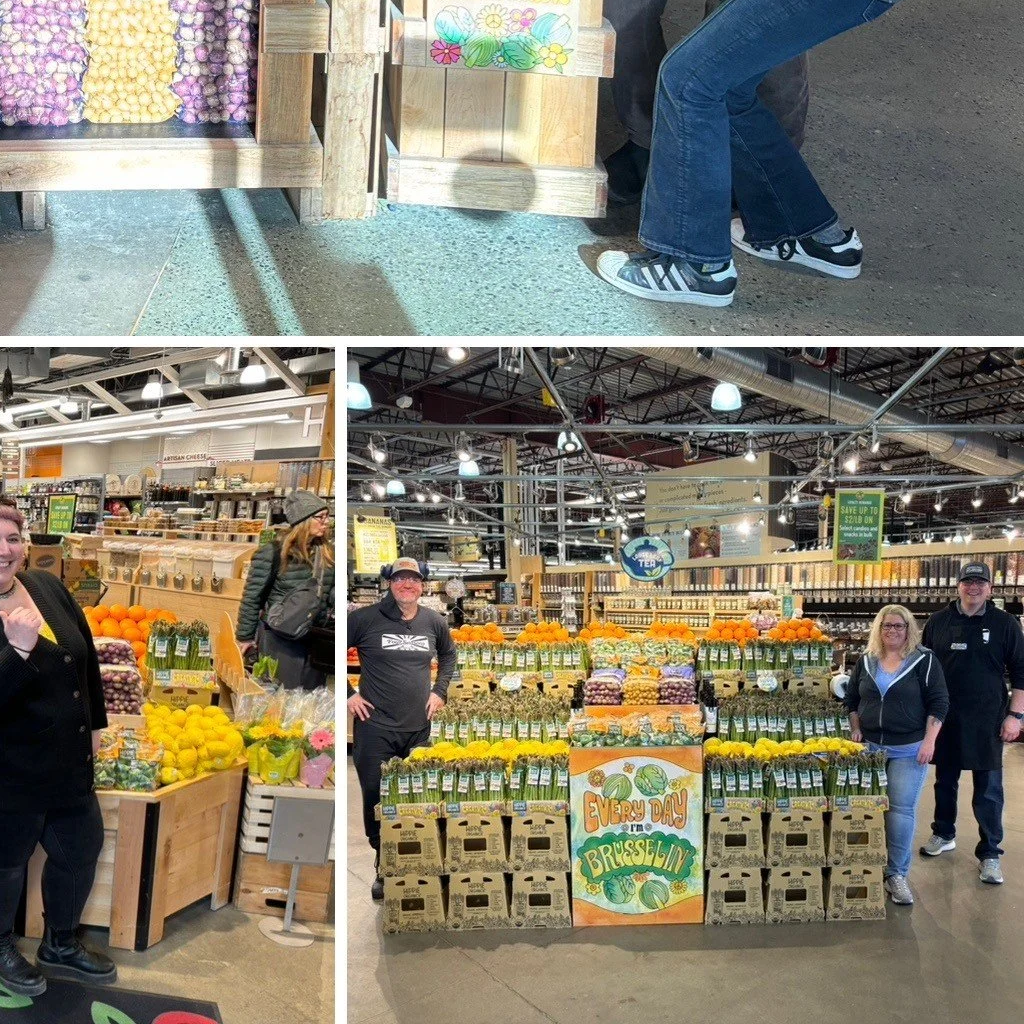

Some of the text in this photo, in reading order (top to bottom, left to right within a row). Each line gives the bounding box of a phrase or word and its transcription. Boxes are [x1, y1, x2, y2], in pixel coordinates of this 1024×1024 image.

[163, 454, 184, 462] ARTISAN
[841, 506, 879, 515] SAVE UP TO
[864, 516, 873, 524] ON
[638, 558, 656, 568] TEA
[583, 788, 688, 833] EVERY DAY
